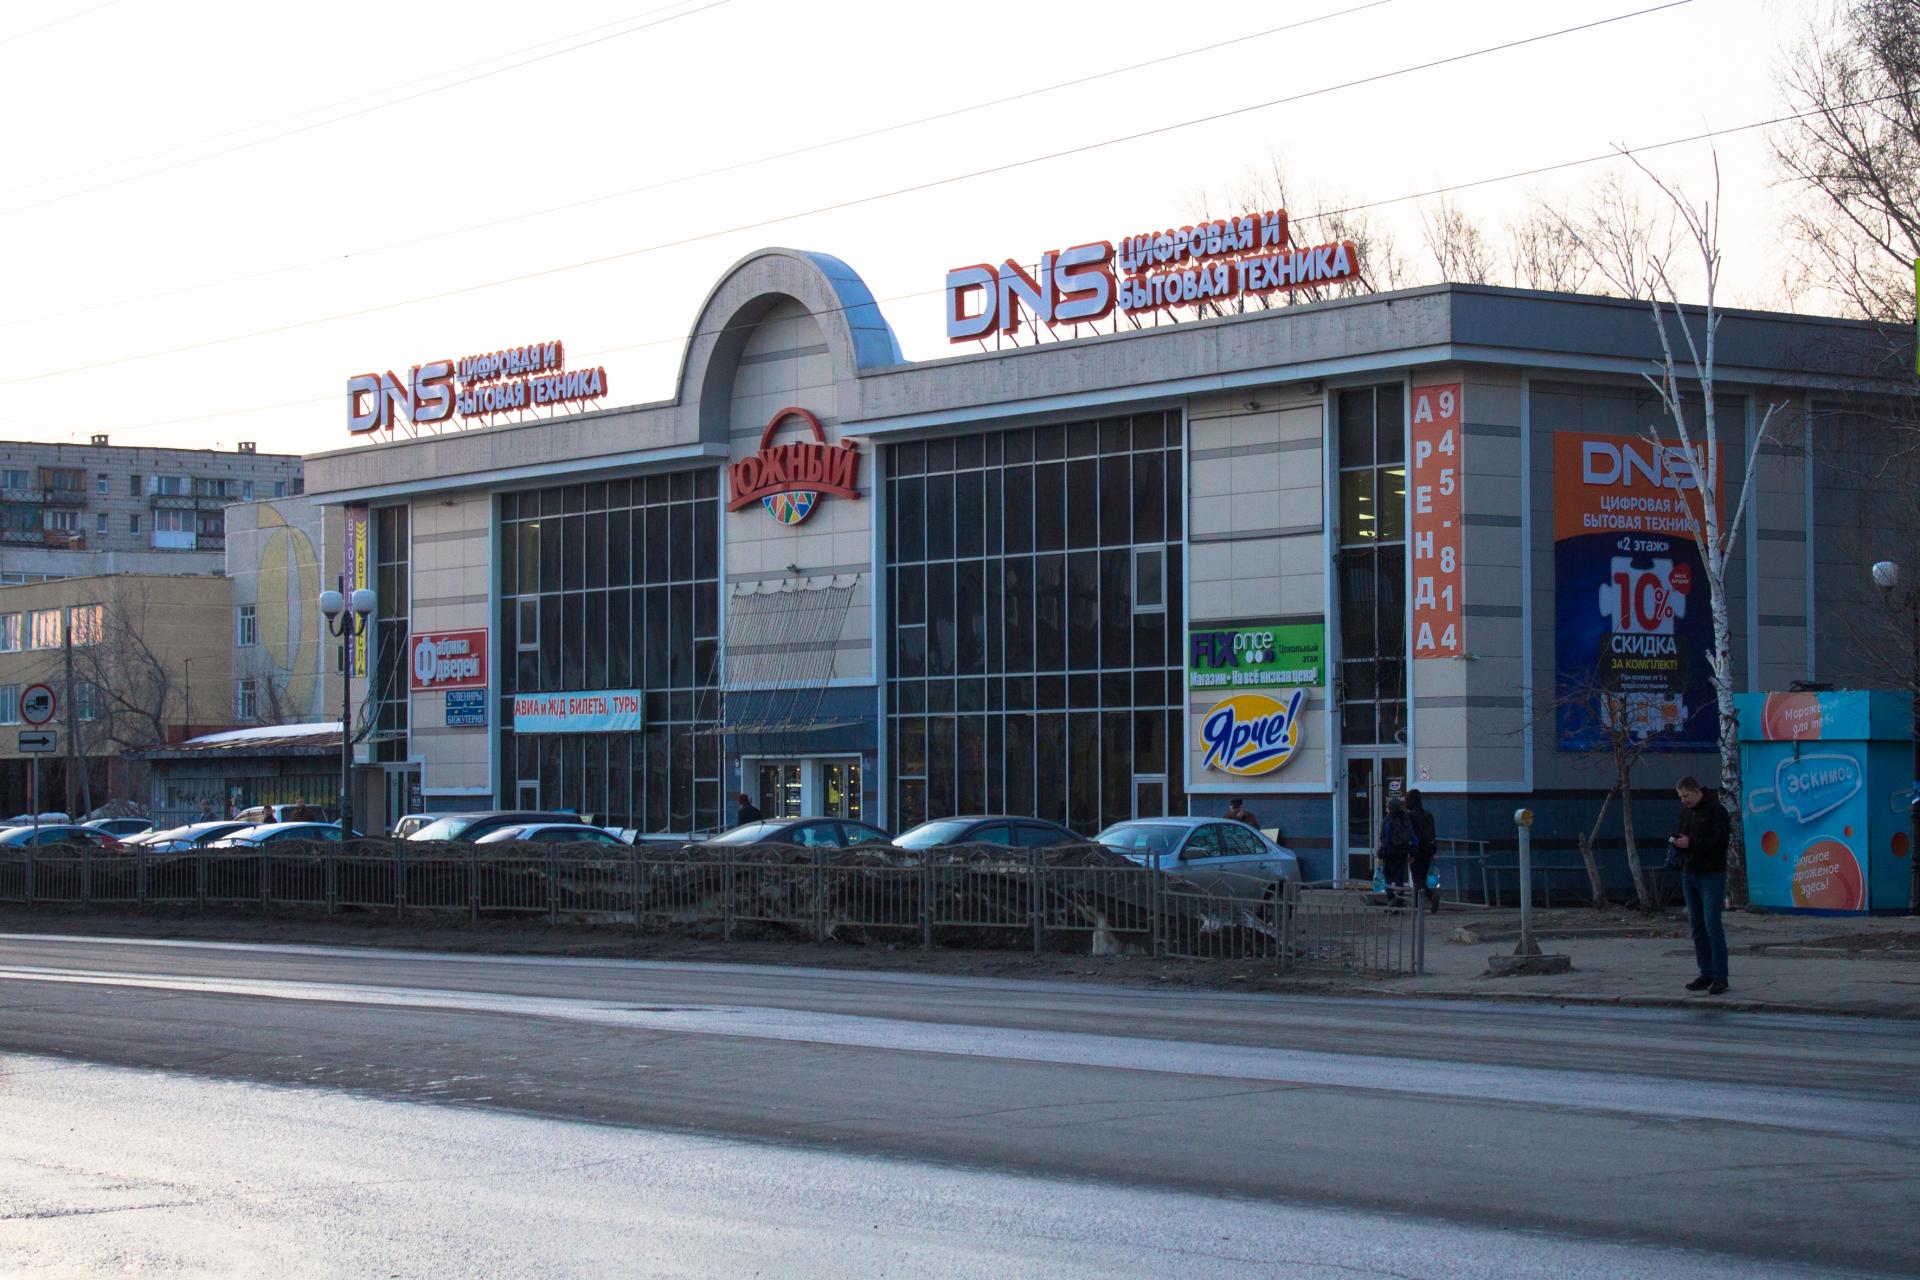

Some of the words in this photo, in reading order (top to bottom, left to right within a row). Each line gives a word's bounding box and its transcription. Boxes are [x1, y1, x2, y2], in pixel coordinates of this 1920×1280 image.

[1118, 214, 1254, 272] ЦИФРОВАЯ
[1260, 211, 1283, 247] И
[946, 243, 1113, 340] DNS
[1118, 262, 1227, 313] БЫТОВАЯ
[1236, 243, 1352, 292] ТЕХНИКА
[456, 344, 541, 384] ЦИФРОВАЯ
[543, 342, 559, 370] И
[347, 361, 452, 433] DNS
[456, 381, 526, 416] БЫТОВАЯ
[528, 369, 602, 402] ТЕХНИКА
[728, 439, 858, 501] ЮЖНЫЙ
[1583, 441, 1699, 489] DNS
[1414, 395, 1436, 650] АРЕНДА
[1439, 391, 1457, 651] 945-814
[1583, 513, 1641, 529] БЫТОВАЯ
[1645, 517, 1700, 532] ТЕХНИКА
[1600, 495, 1671, 513] ЦИФРОВАЯ
[1674, 499, 1686, 514] И
[1617, 537, 1631, 551] «2
[1634, 540, 1669, 552] этаж»
[1614, 572, 1674, 631] 10%
[415, 636, 470, 687] Фабрика
[436, 652, 480, 682] дверей
[1190, 631, 1239, 668] FIX
[1233, 631, 1273, 654] price
[1302, 655, 1319, 664] этаж
[1611, 636, 1677, 657] СКИДКА
[1612, 659, 1623, 669] ЗА
[1626, 659, 1677, 670] КОМПЛЕКТ!
[447, 691, 483, 702] СУВЕНИРЫ
[1190, 671, 1226, 686] Магазин
[1232, 669, 1242, 685] На
[1244, 669, 1258, 684] всё
[1260, 670, 1291, 684] низкая
[1293, 667, 1319, 685] цена!
[514, 699, 539, 716] АВИА
[541, 702, 546, 716] и
[548, 699, 566, 719] Ж/Д
[569, 697, 609, 717] БИЛЕТЫ,
[613, 696, 638, 713] ТУРЫ
[1203, 690, 1302, 767] Ярче!
[1788, 767, 1854, 793] ЭСКИМОС
